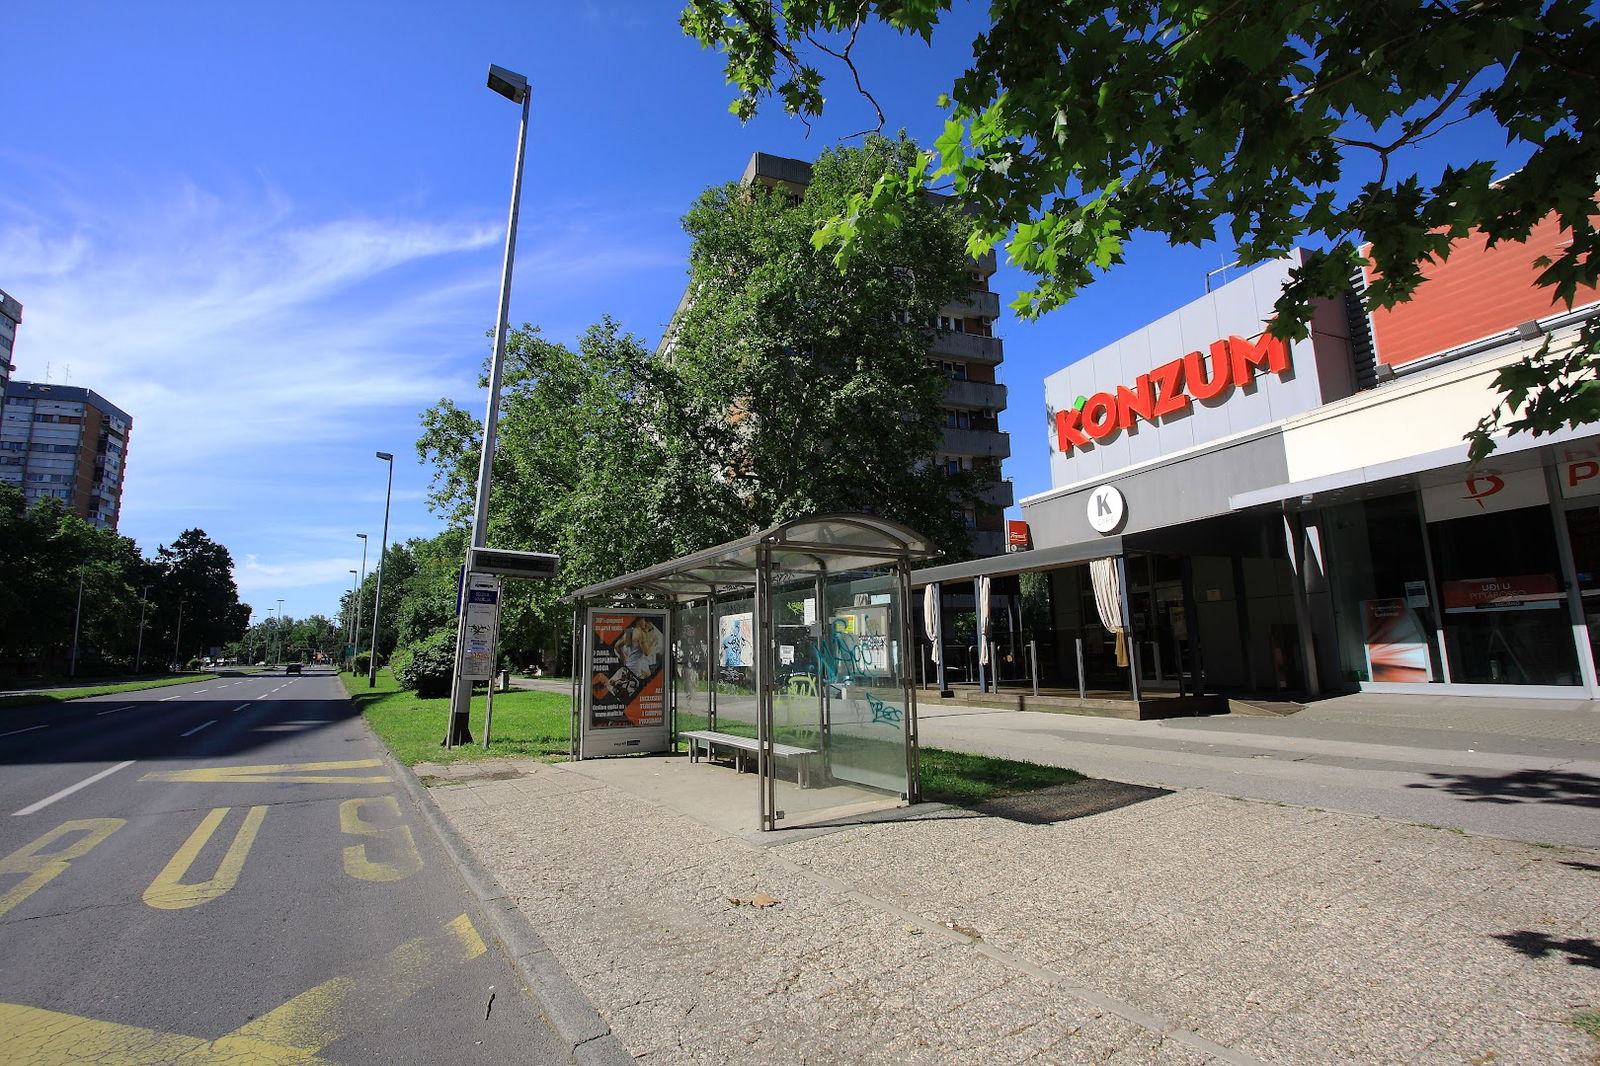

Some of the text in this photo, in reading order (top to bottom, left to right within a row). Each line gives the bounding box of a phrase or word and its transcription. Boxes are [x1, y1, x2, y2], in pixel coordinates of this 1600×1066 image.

[1056, 315, 1290, 452] KONZUM
[1096, 491, 1112, 517] K
[1502, 582, 1511, 590] U
